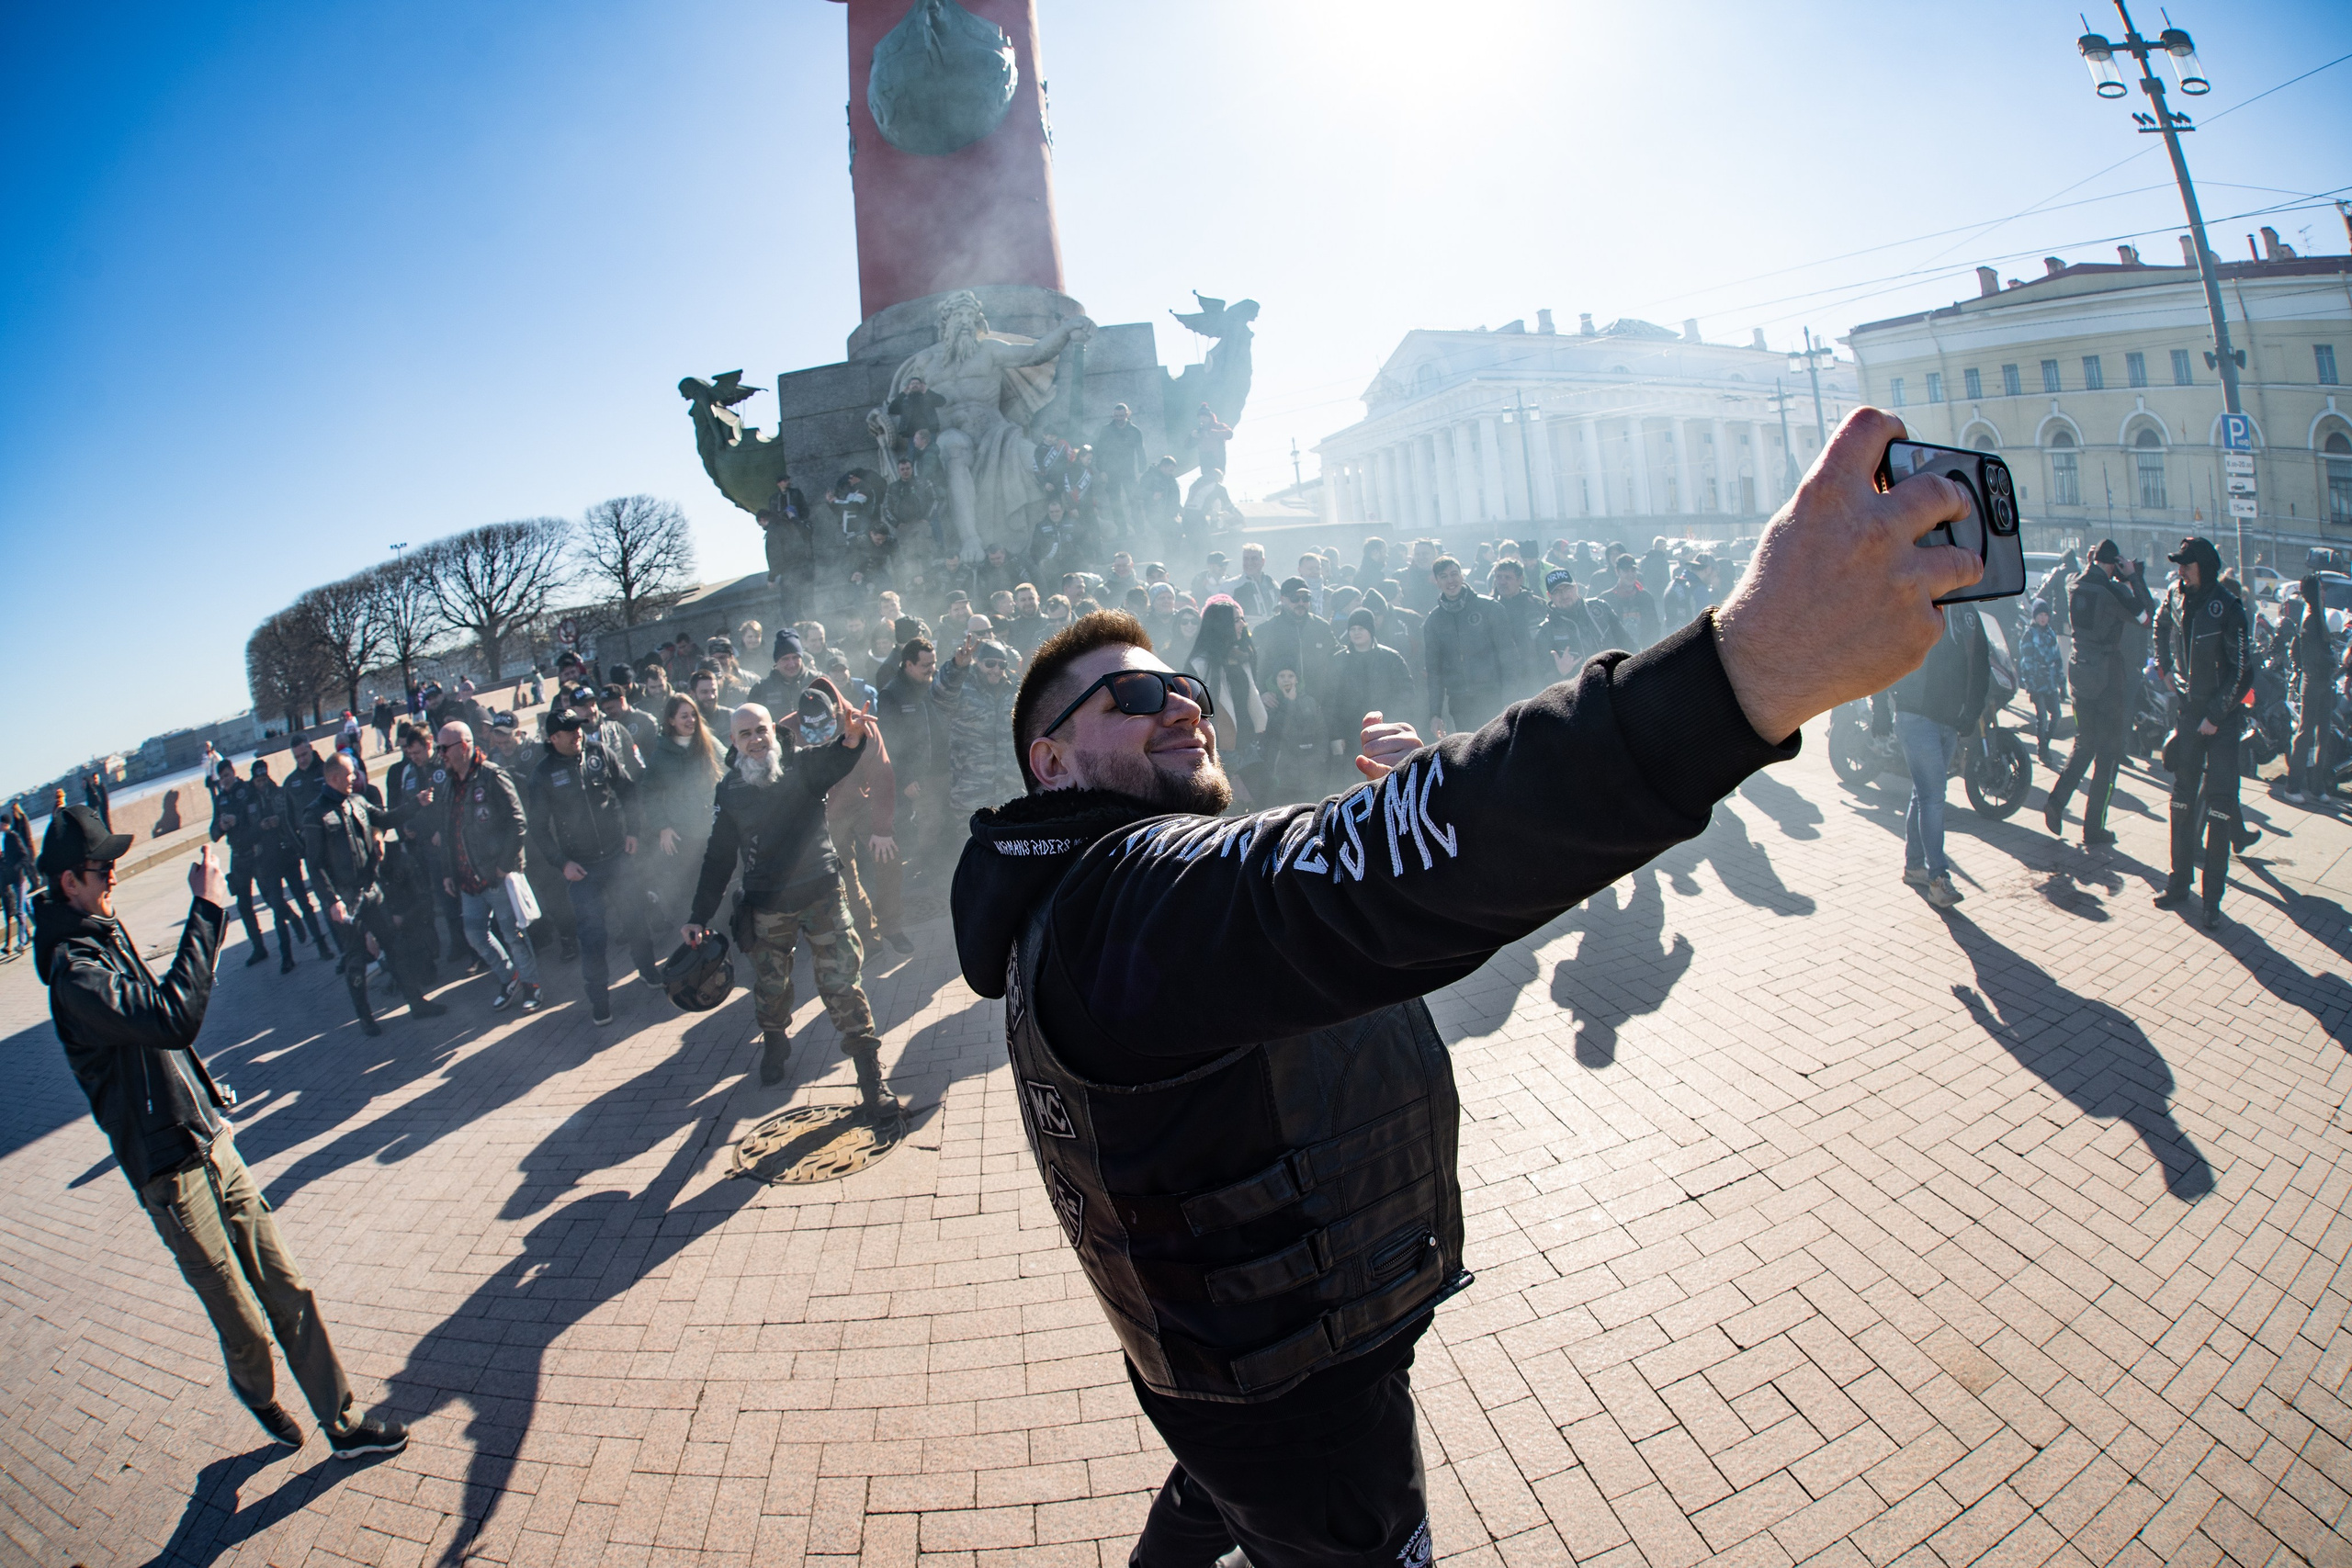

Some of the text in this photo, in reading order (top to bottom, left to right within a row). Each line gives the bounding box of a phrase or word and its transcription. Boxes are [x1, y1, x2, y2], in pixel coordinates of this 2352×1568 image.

[2229, 418, 2245, 446] P
[1546, 571, 1568, 585] NRMC
[1384, 750, 1458, 877] MC
[1030, 839, 1070, 855] RIDERS
[1030, 1088, 1066, 1133] MC
